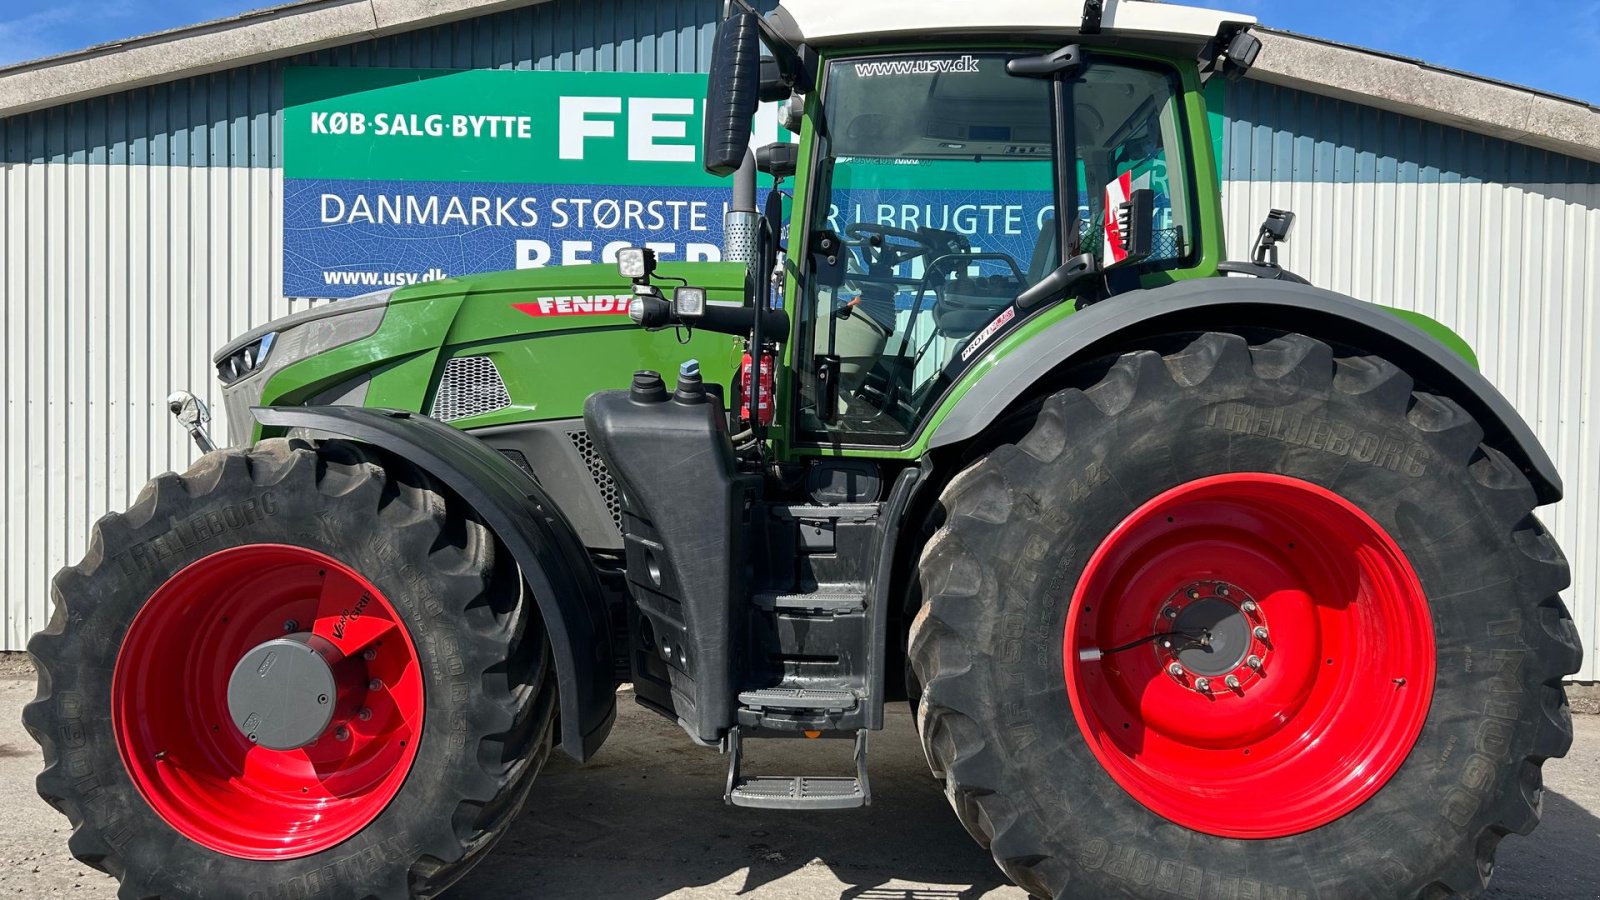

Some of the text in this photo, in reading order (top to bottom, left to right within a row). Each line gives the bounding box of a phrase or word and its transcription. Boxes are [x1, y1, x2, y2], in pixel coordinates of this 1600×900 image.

[855, 55, 979, 77] www.usv.dk
[320, 193, 538, 228] DANMARKS
[551, 198, 707, 231] STØRSTE
[876, 204, 1023, 235] BRUGTE
[323, 268, 447, 287] www.usv.dk
[537, 294, 634, 314] FENDT
[1203, 401, 1433, 479] TRELLEBORG
[112, 490, 280, 577] TRELLEBORG
[349, 590, 371, 622] GRIP
[1439, 608, 1529, 828] TM1060
